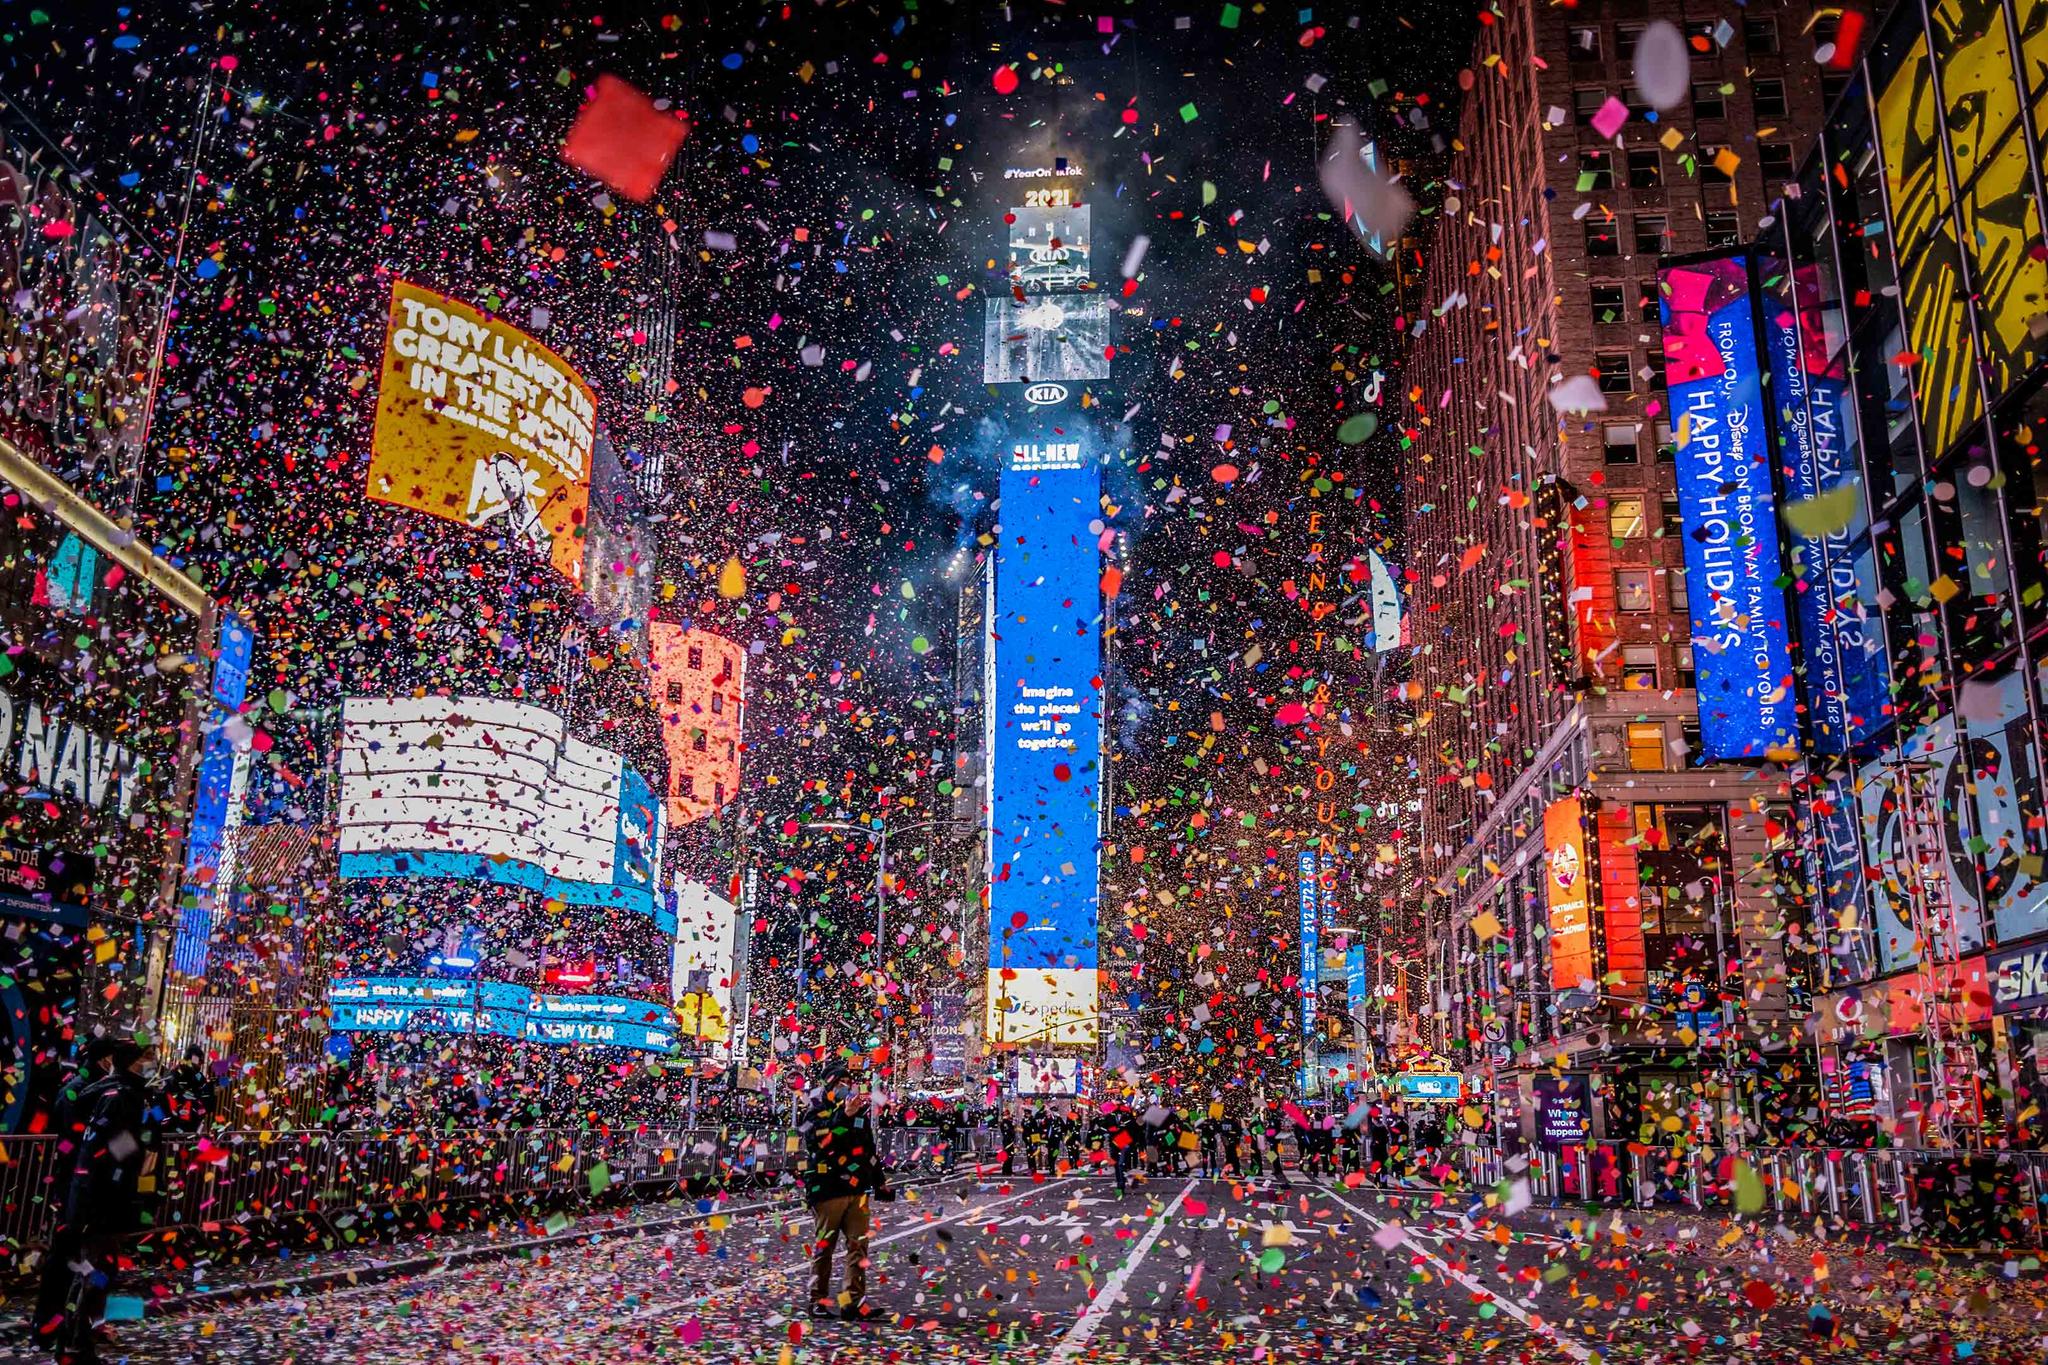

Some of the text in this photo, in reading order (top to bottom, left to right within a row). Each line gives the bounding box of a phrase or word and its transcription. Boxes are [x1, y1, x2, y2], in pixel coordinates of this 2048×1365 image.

[1025, 189, 1069, 207] 2021
[402, 298, 490, 351] TORY
[1719, 322, 1736, 363] FROM
[410, 362, 447, 397] IN
[454, 376, 511, 424] THE
[1032, 387, 1061, 399] KIA
[1726, 403, 1749, 461] Disney
[1013, 443, 1080, 462] ALL-NEW
[1734, 465, 1750, 489] ON
[1688, 390, 1742, 650] HAPPY HOLIDAYS
[1748, 586, 1766, 643] FAMILY
[1756, 645, 1769, 666] TO
[1023, 686, 1074, 700] imagine
[1014, 703, 1081, 716] the places
[1021, 719, 1051, 731] we'll
[20, 702, 147, 816] NAVY
[356, 1008, 404, 1026] HAPPY
[1547, 1109, 1579, 1118] Whre
[1545, 1127, 1584, 1137] happens
